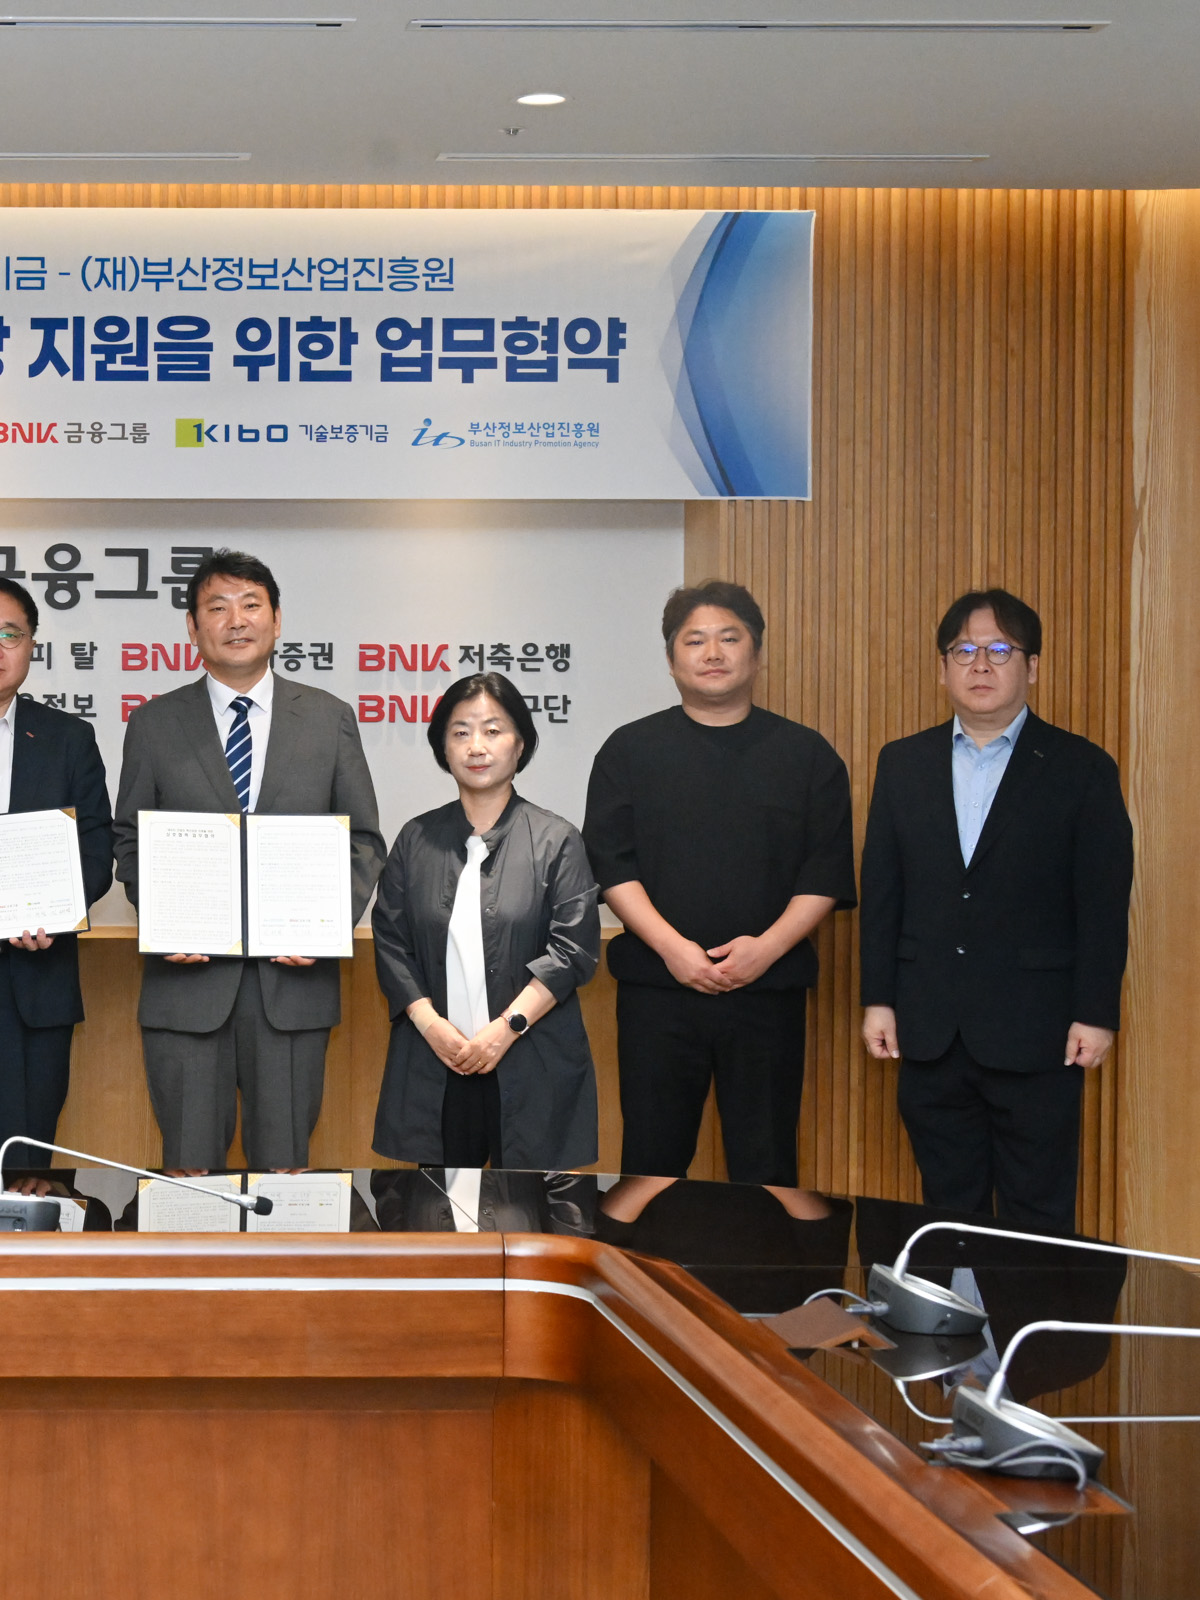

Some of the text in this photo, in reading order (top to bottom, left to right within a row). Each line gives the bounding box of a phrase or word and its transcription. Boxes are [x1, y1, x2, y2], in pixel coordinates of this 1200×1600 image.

[80, 256, 455, 292] (재)부산정보산업진흥원
[27, 315, 214, 383] 지원을
[232, 316, 360, 383] 위한
[375, 316, 628, 384] 업무협약
[63, 421, 151, 444] 금융그룹
[298, 424, 390, 443] 기술보증기금
[468, 421, 600, 438] 부산정보산업진흥원
[469, 439, 600, 449] Busan IT Industry Promotion Agency
[358, 642, 571, 673] BNK 저축은행
